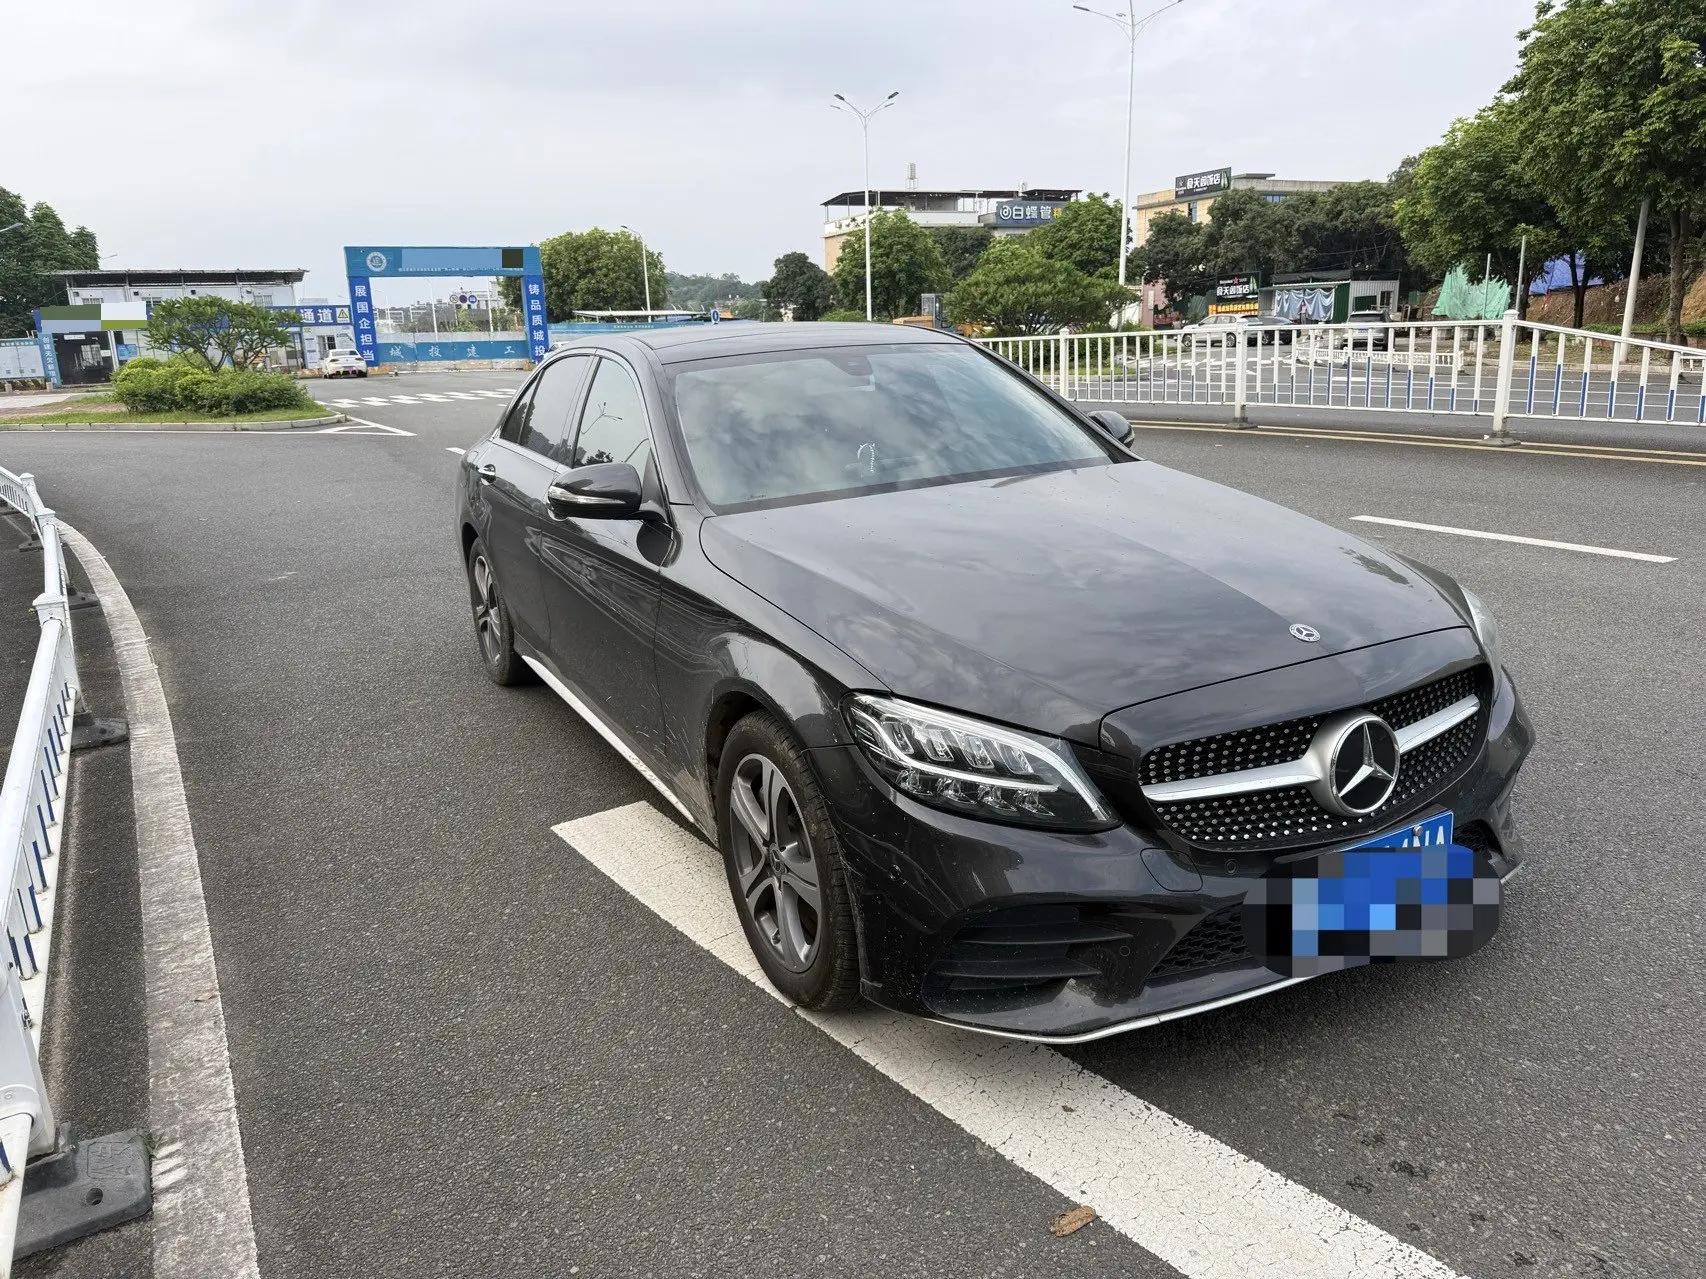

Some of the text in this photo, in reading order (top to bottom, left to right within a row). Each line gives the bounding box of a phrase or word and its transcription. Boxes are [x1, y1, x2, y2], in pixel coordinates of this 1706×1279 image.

[300, 308, 333, 323] 通道
[355, 285, 375, 361] 展国企担当
[528, 284, 546, 357] 铸品质城投
[390, 344, 515, 359] 城投建工
